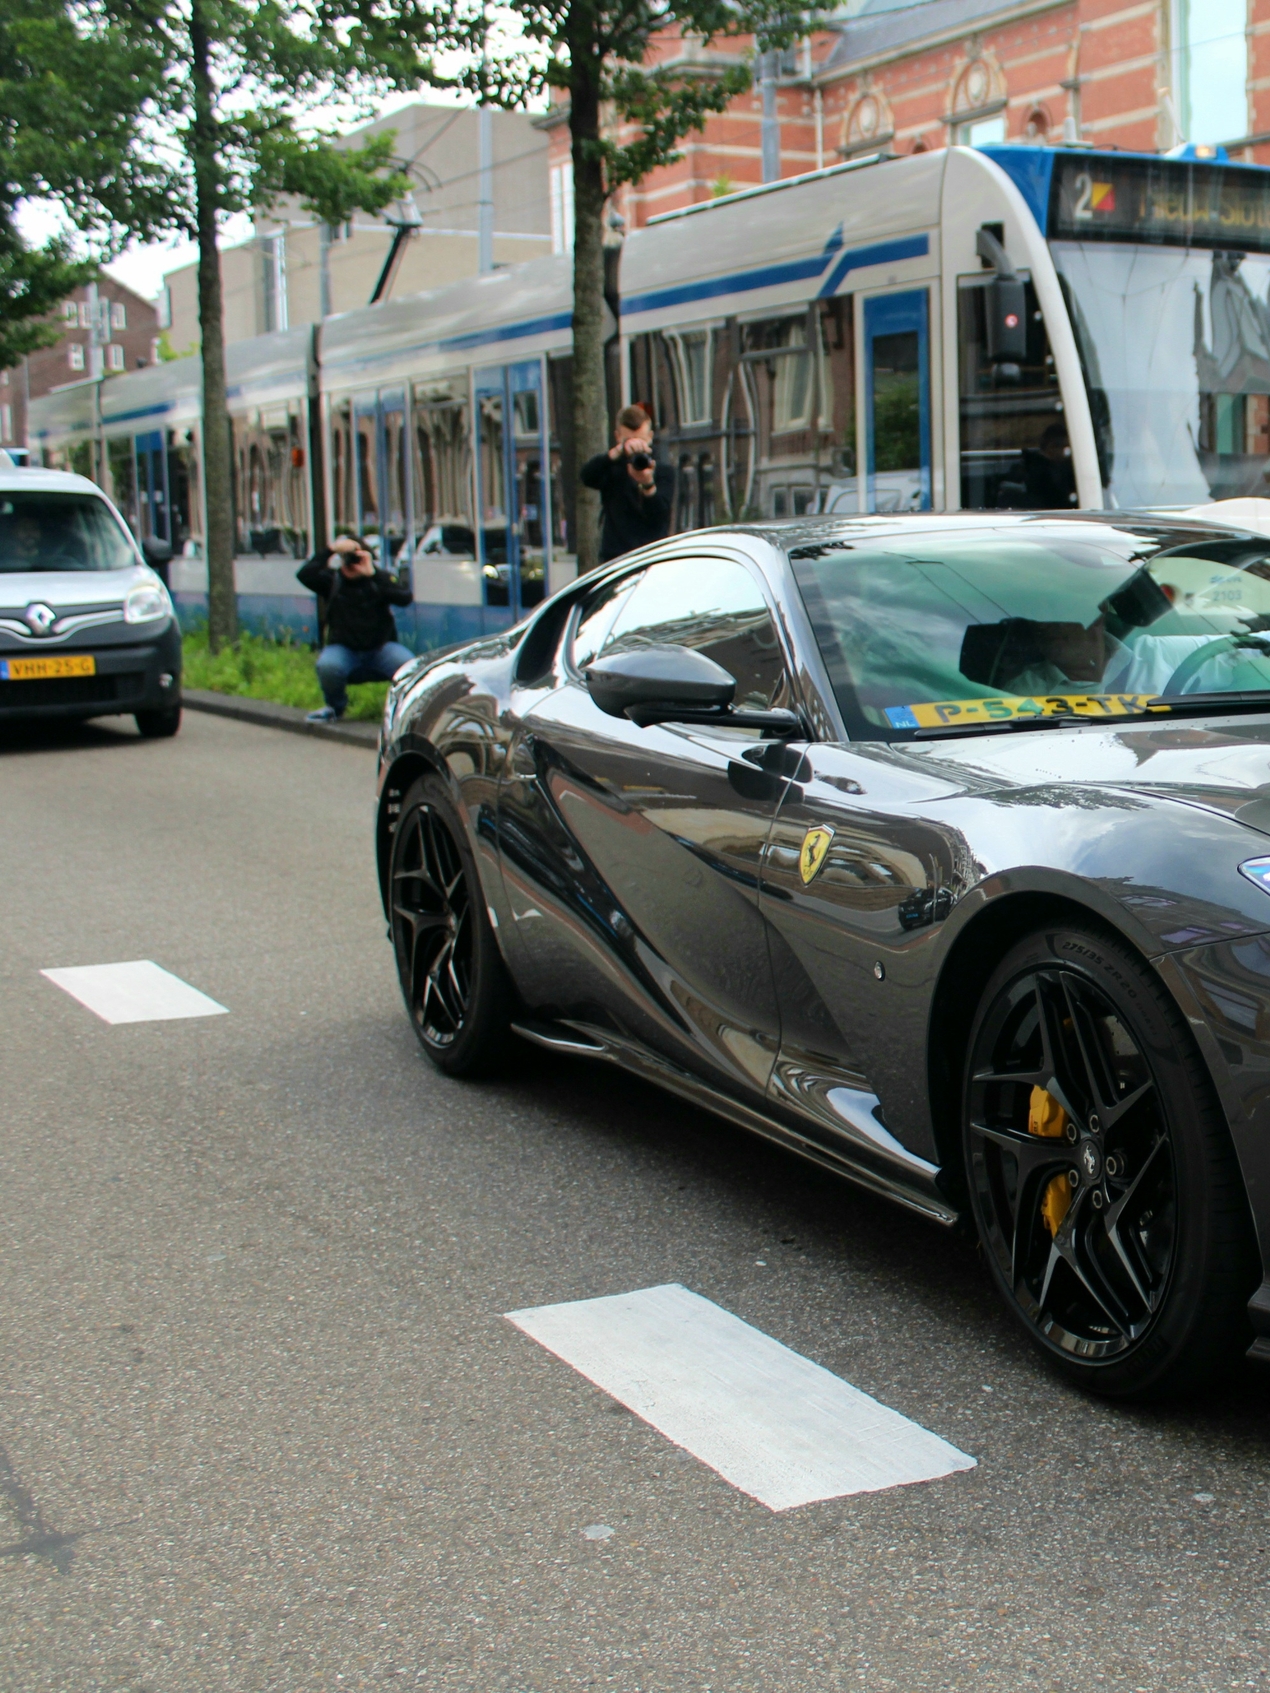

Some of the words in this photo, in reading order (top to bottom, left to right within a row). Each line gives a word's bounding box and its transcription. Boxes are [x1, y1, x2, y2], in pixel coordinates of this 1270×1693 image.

[1074, 171, 1093, 220] 2
[894, 719, 916, 728] NL
[1062, 941, 1104, 965] 275/35
